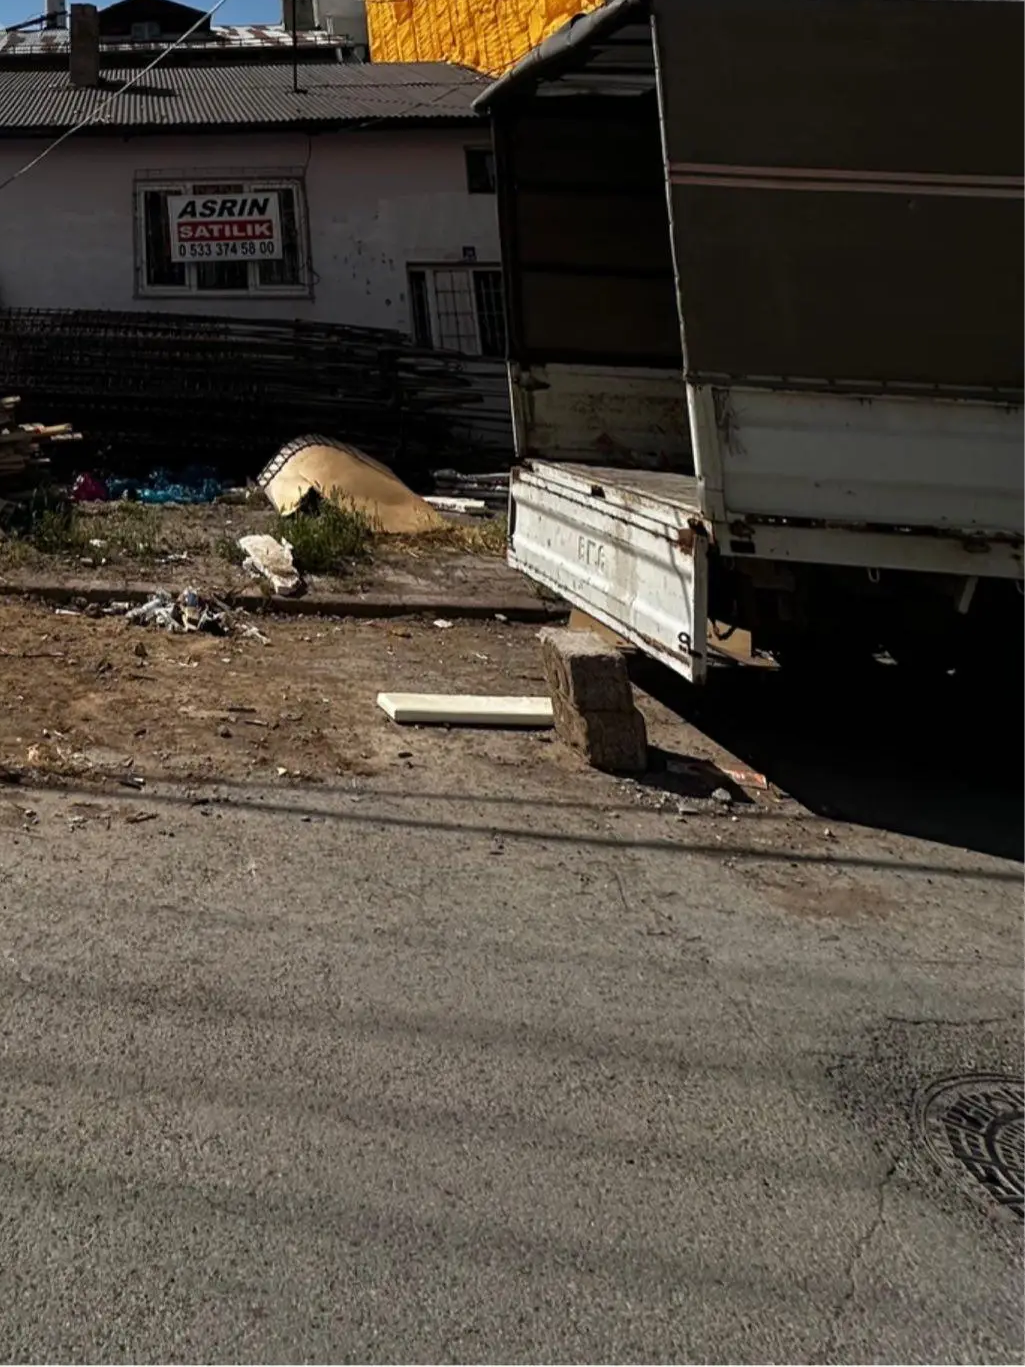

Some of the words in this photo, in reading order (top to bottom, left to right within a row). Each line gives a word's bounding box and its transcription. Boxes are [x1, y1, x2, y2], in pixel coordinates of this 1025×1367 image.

[178, 198, 269, 218] ASRIN
[179, 224, 271, 238] SATILIK
[179, 244, 187, 257] 0
[190, 243, 212, 257] 533
[215, 242, 238, 256] 374
[241, 241, 256, 255] 58
[259, 240, 275, 254] 00
